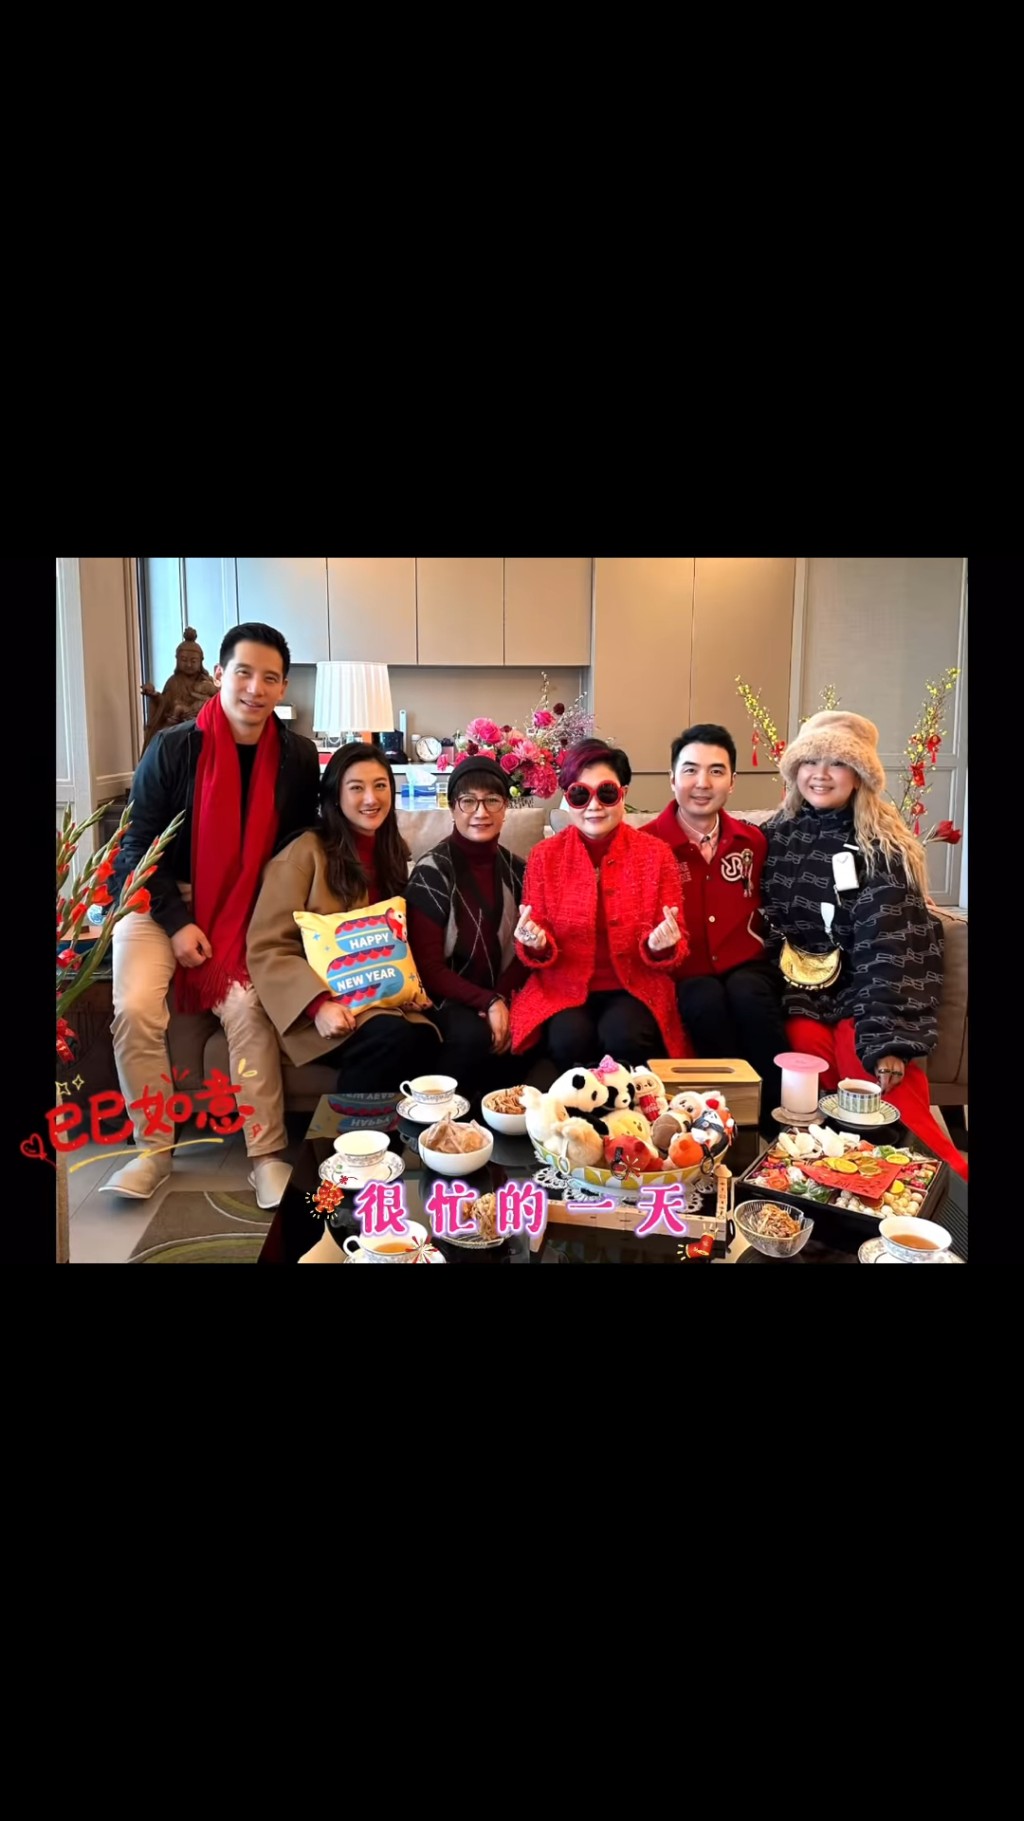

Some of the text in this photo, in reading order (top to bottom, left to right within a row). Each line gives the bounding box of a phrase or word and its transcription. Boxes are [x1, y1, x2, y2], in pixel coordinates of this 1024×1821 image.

[349, 932, 390, 950] HAPPY
[336, 967, 396, 992] NEW YEAR
